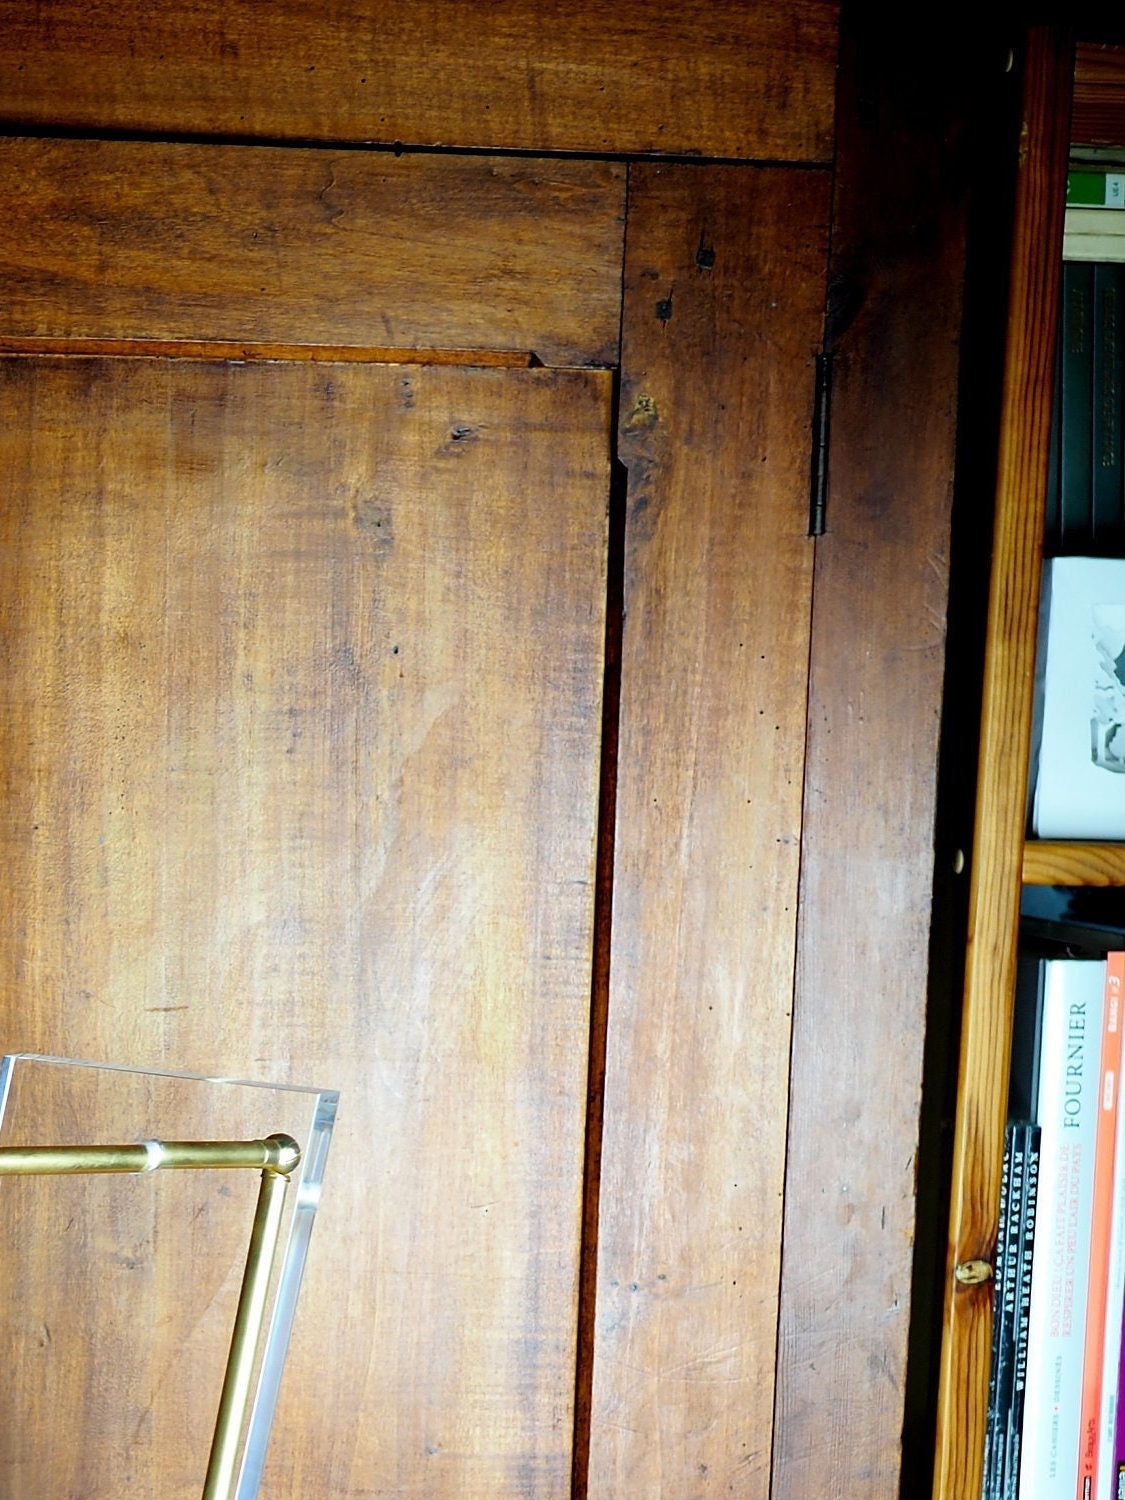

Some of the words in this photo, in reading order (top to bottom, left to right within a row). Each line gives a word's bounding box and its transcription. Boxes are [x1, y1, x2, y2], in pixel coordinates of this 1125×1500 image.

[1063, 1001, 1086, 1128] FOURNIER
[1059, 1143, 1069, 1161] DE
[1010, 1152, 1023, 1234] RACKHAM
[1025, 1152, 1039, 1240] ROBINSON
[1004, 1244, 1017, 1313] ARTHUR
[1021, 1250, 1032, 1307] HEATH
[1016, 1317, 1028, 1391] WILLIAM
